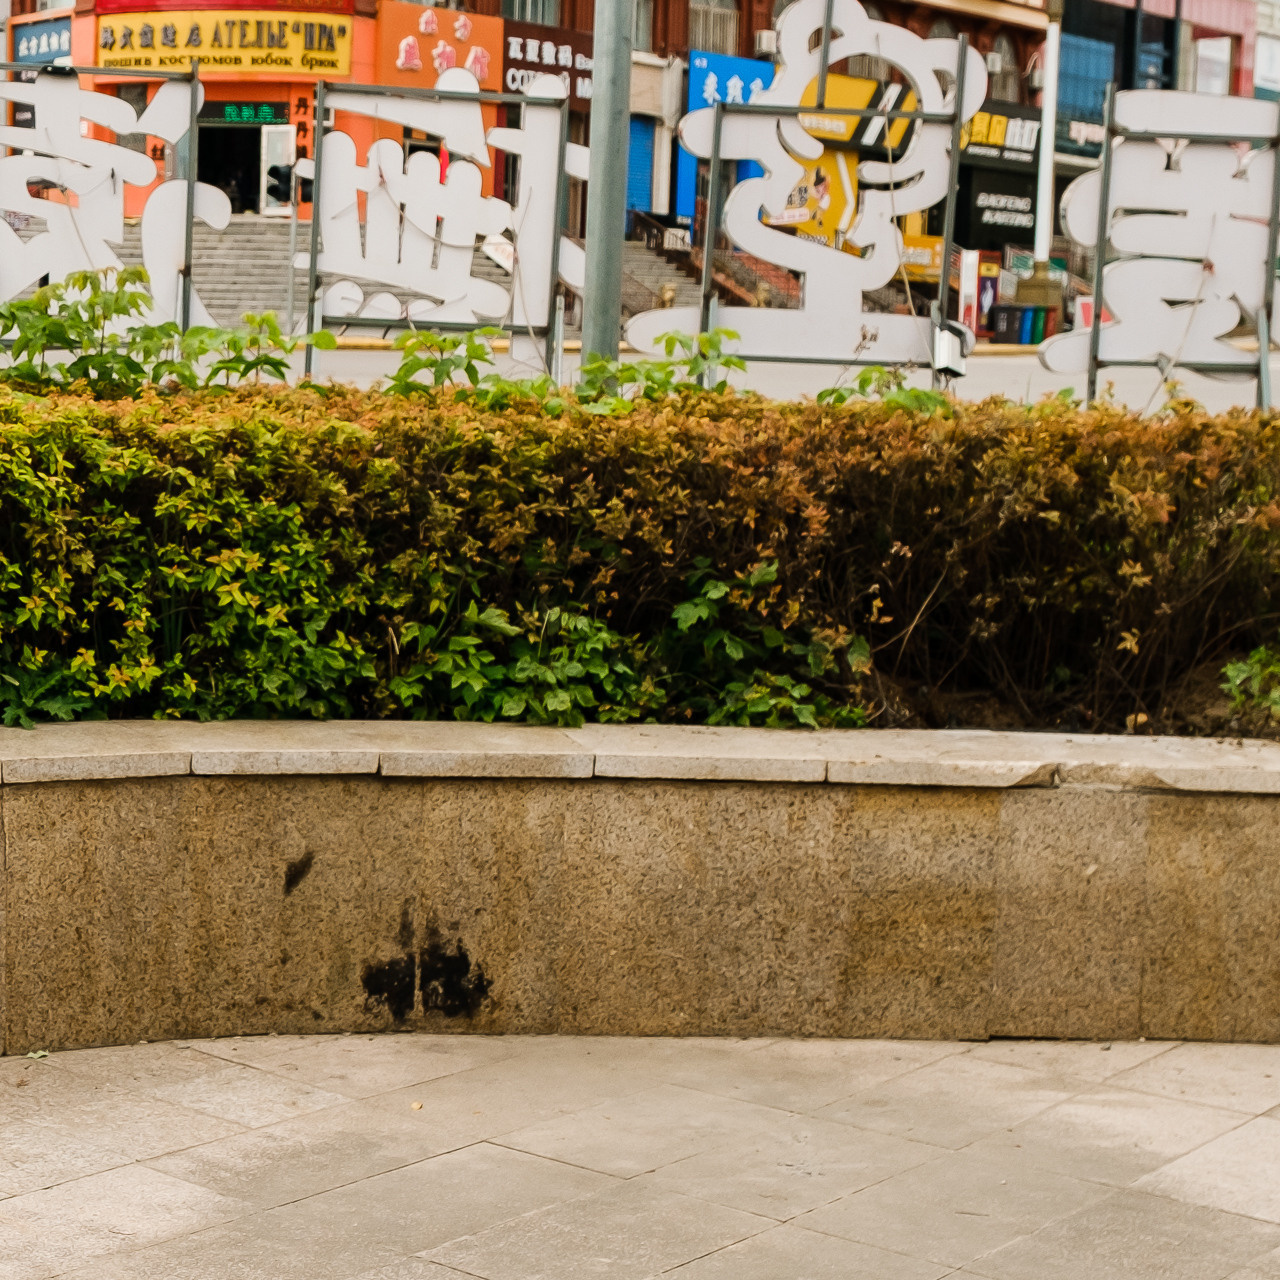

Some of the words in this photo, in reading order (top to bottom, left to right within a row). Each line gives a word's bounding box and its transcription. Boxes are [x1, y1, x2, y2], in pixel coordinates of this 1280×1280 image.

[211, 19, 288, 49] АТЕЛЬЕ
[158, 54, 243, 66] костюмов
[250, 52, 293, 67] юбок
[301, 53, 340, 71] брюк
